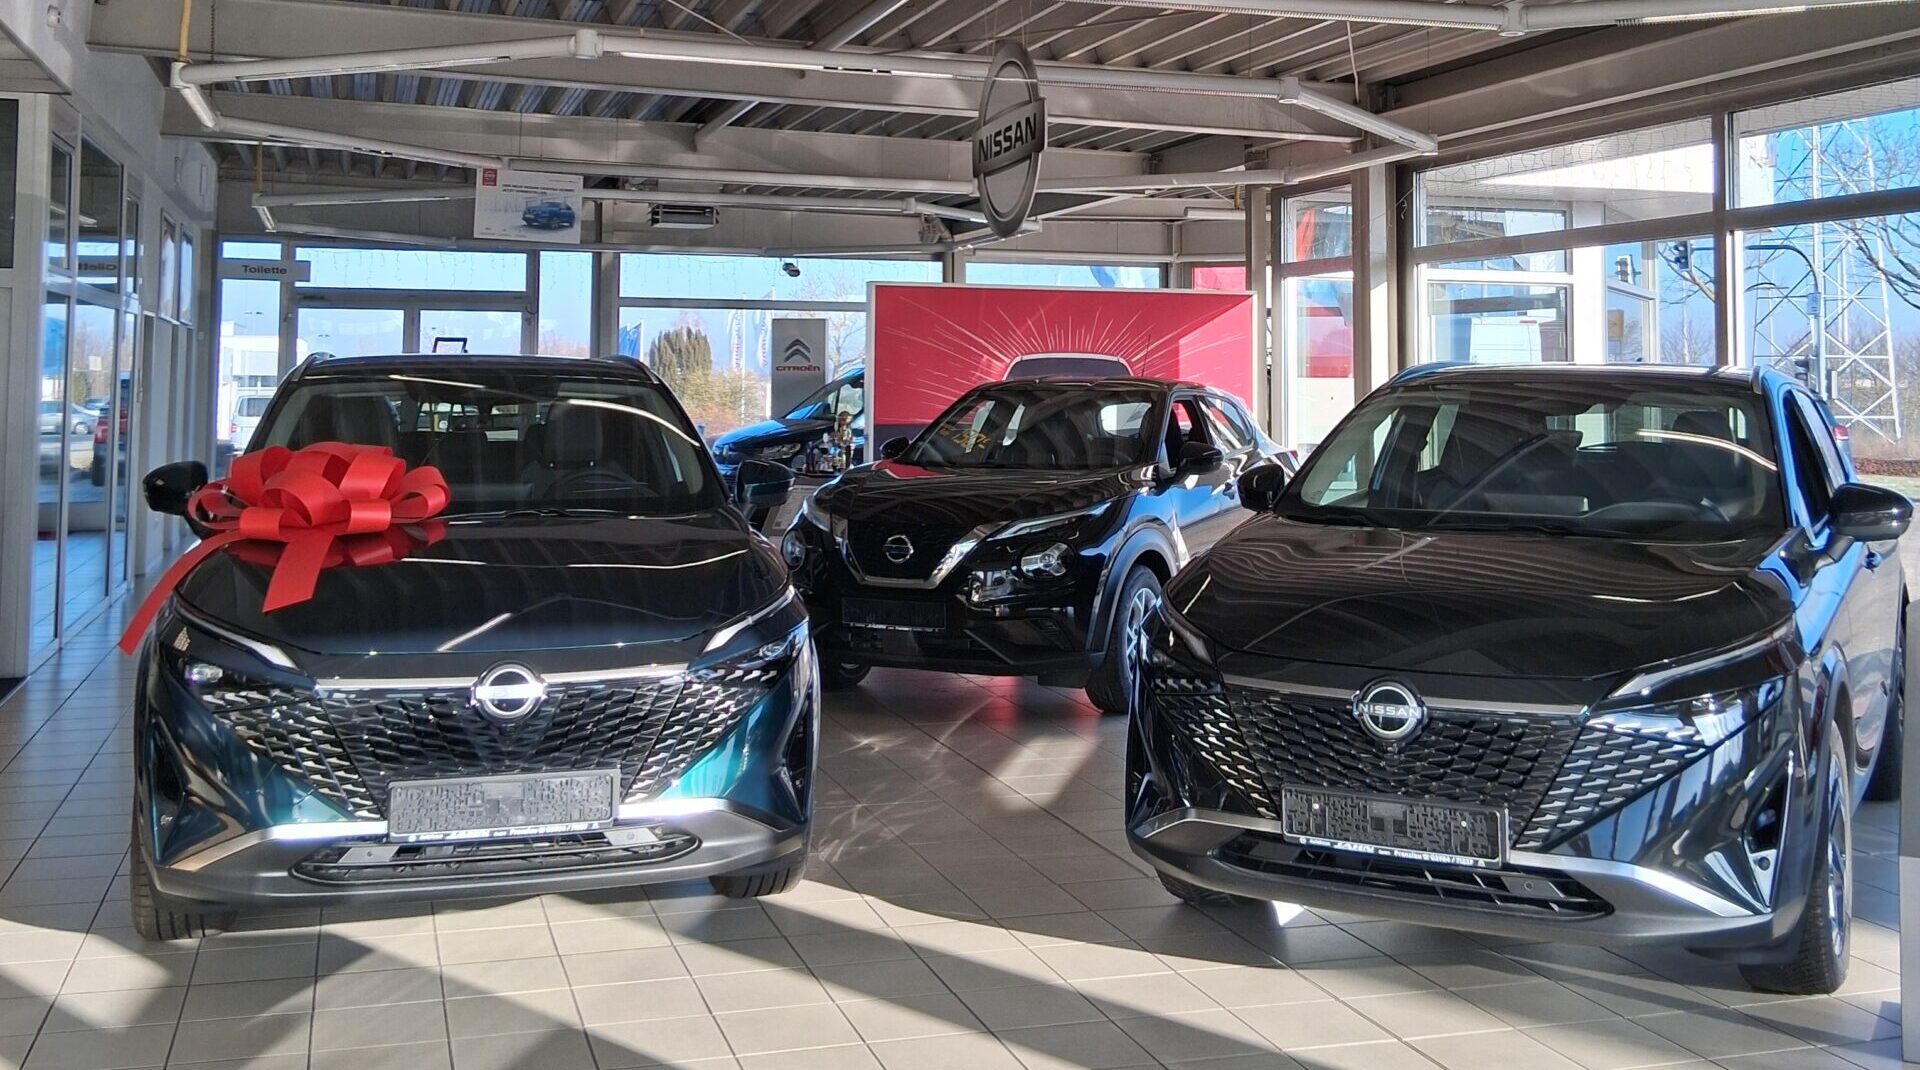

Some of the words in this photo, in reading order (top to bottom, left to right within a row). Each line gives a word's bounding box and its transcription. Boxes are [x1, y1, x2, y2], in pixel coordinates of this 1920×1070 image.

[979, 112, 1037, 163] NISSAN
[241, 265, 287, 274] Toilette
[1360, 703, 1419, 717] NISSAN
